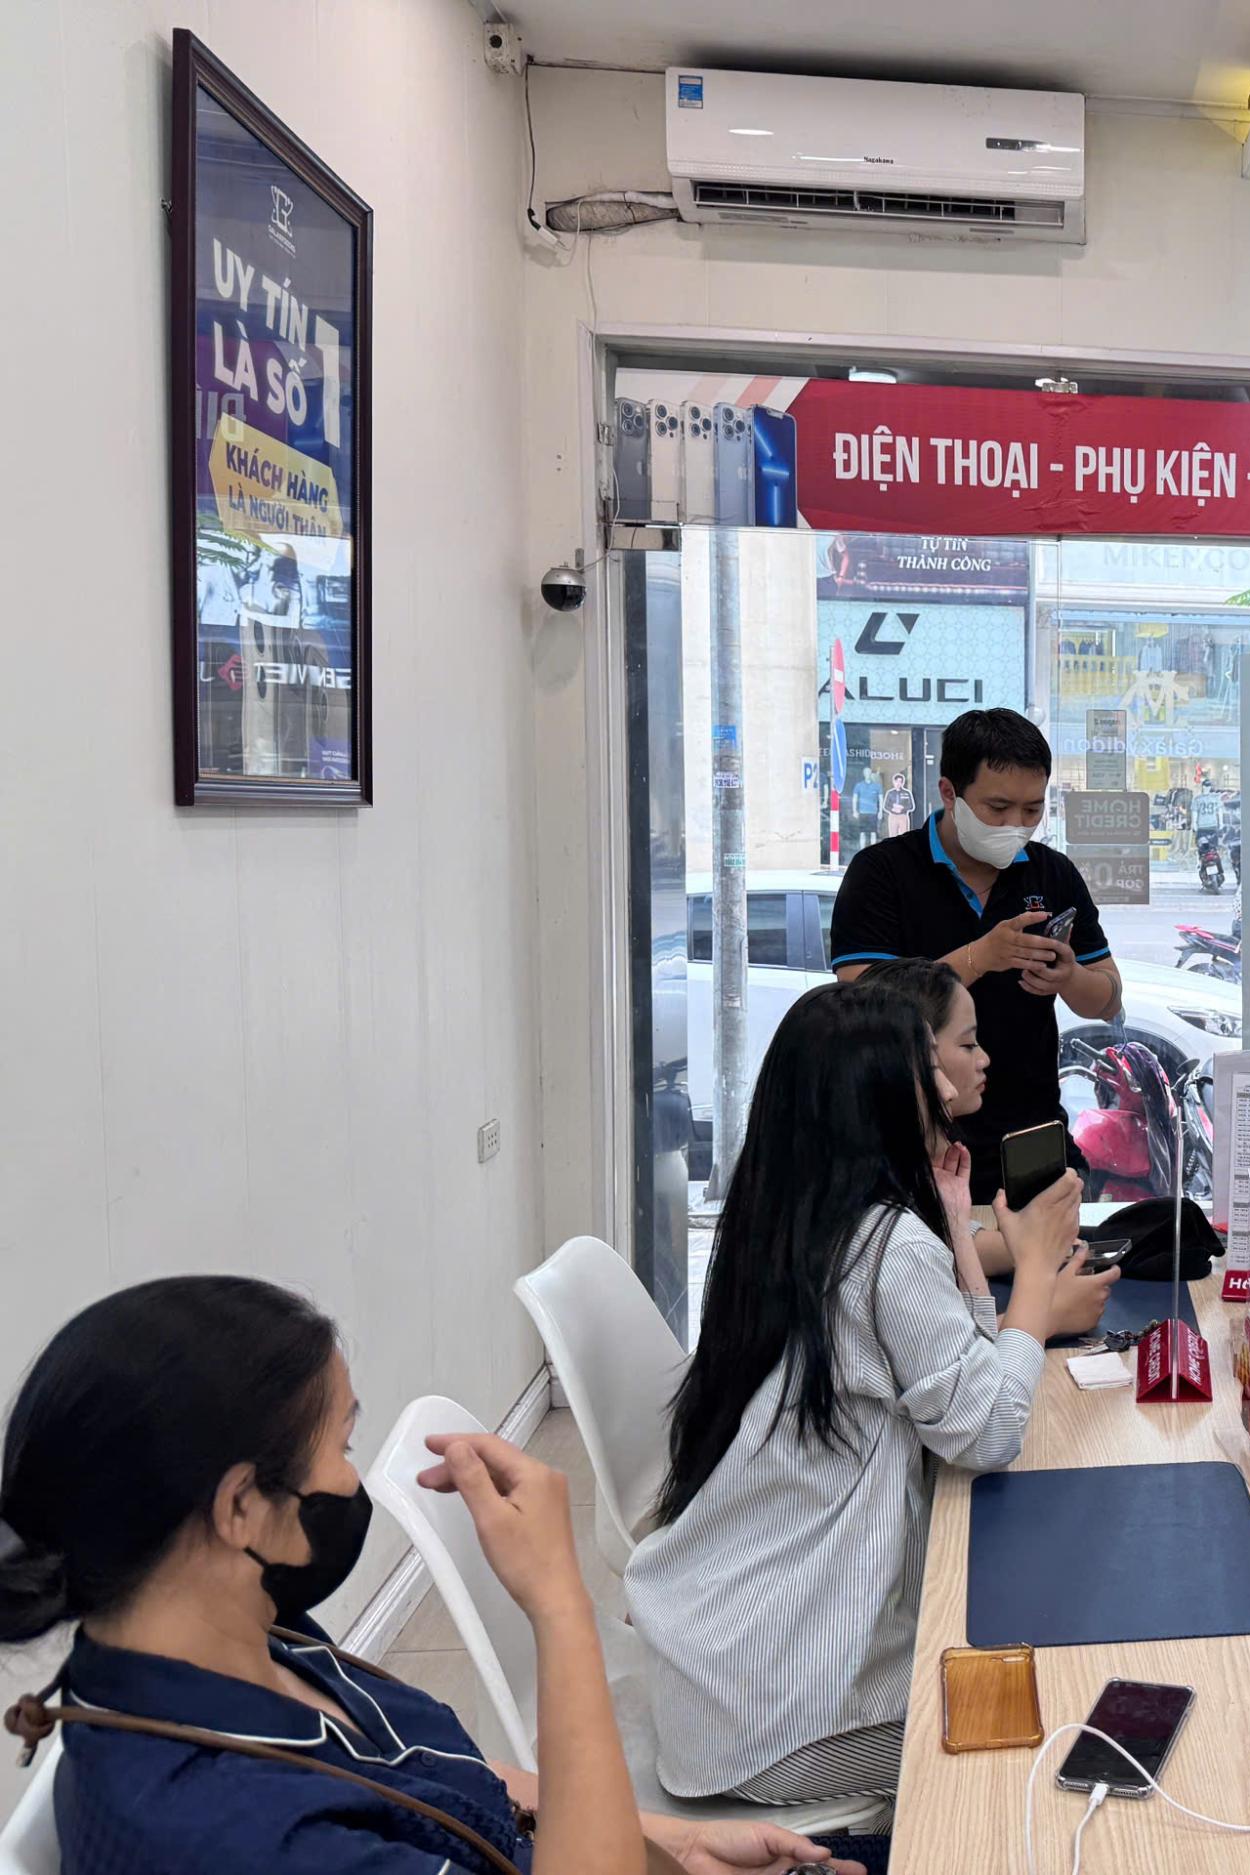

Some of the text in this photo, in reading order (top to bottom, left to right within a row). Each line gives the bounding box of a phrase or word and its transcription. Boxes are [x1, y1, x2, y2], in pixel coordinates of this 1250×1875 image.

[213, 237, 308, 352] UY TÍN
[213, 317, 259, 402] LÀ
[266, 357, 307, 426] SỐ
[225, 441, 329, 513] KHÁCH HÀNG
[832, 424, 921, 492] ĐIỆN
[929, 435, 1039, 499] THOẠI
[1075, 444, 1144, 505] PHỤ
[1155, 441, 1238, 507] KIỆN
[228, 481, 247, 513] LÀ
[249, 493, 289, 532] NGƯỜI
[897, 554, 992, 571] THÀNH CÔNG
[943, 538, 968, 552] TIN
